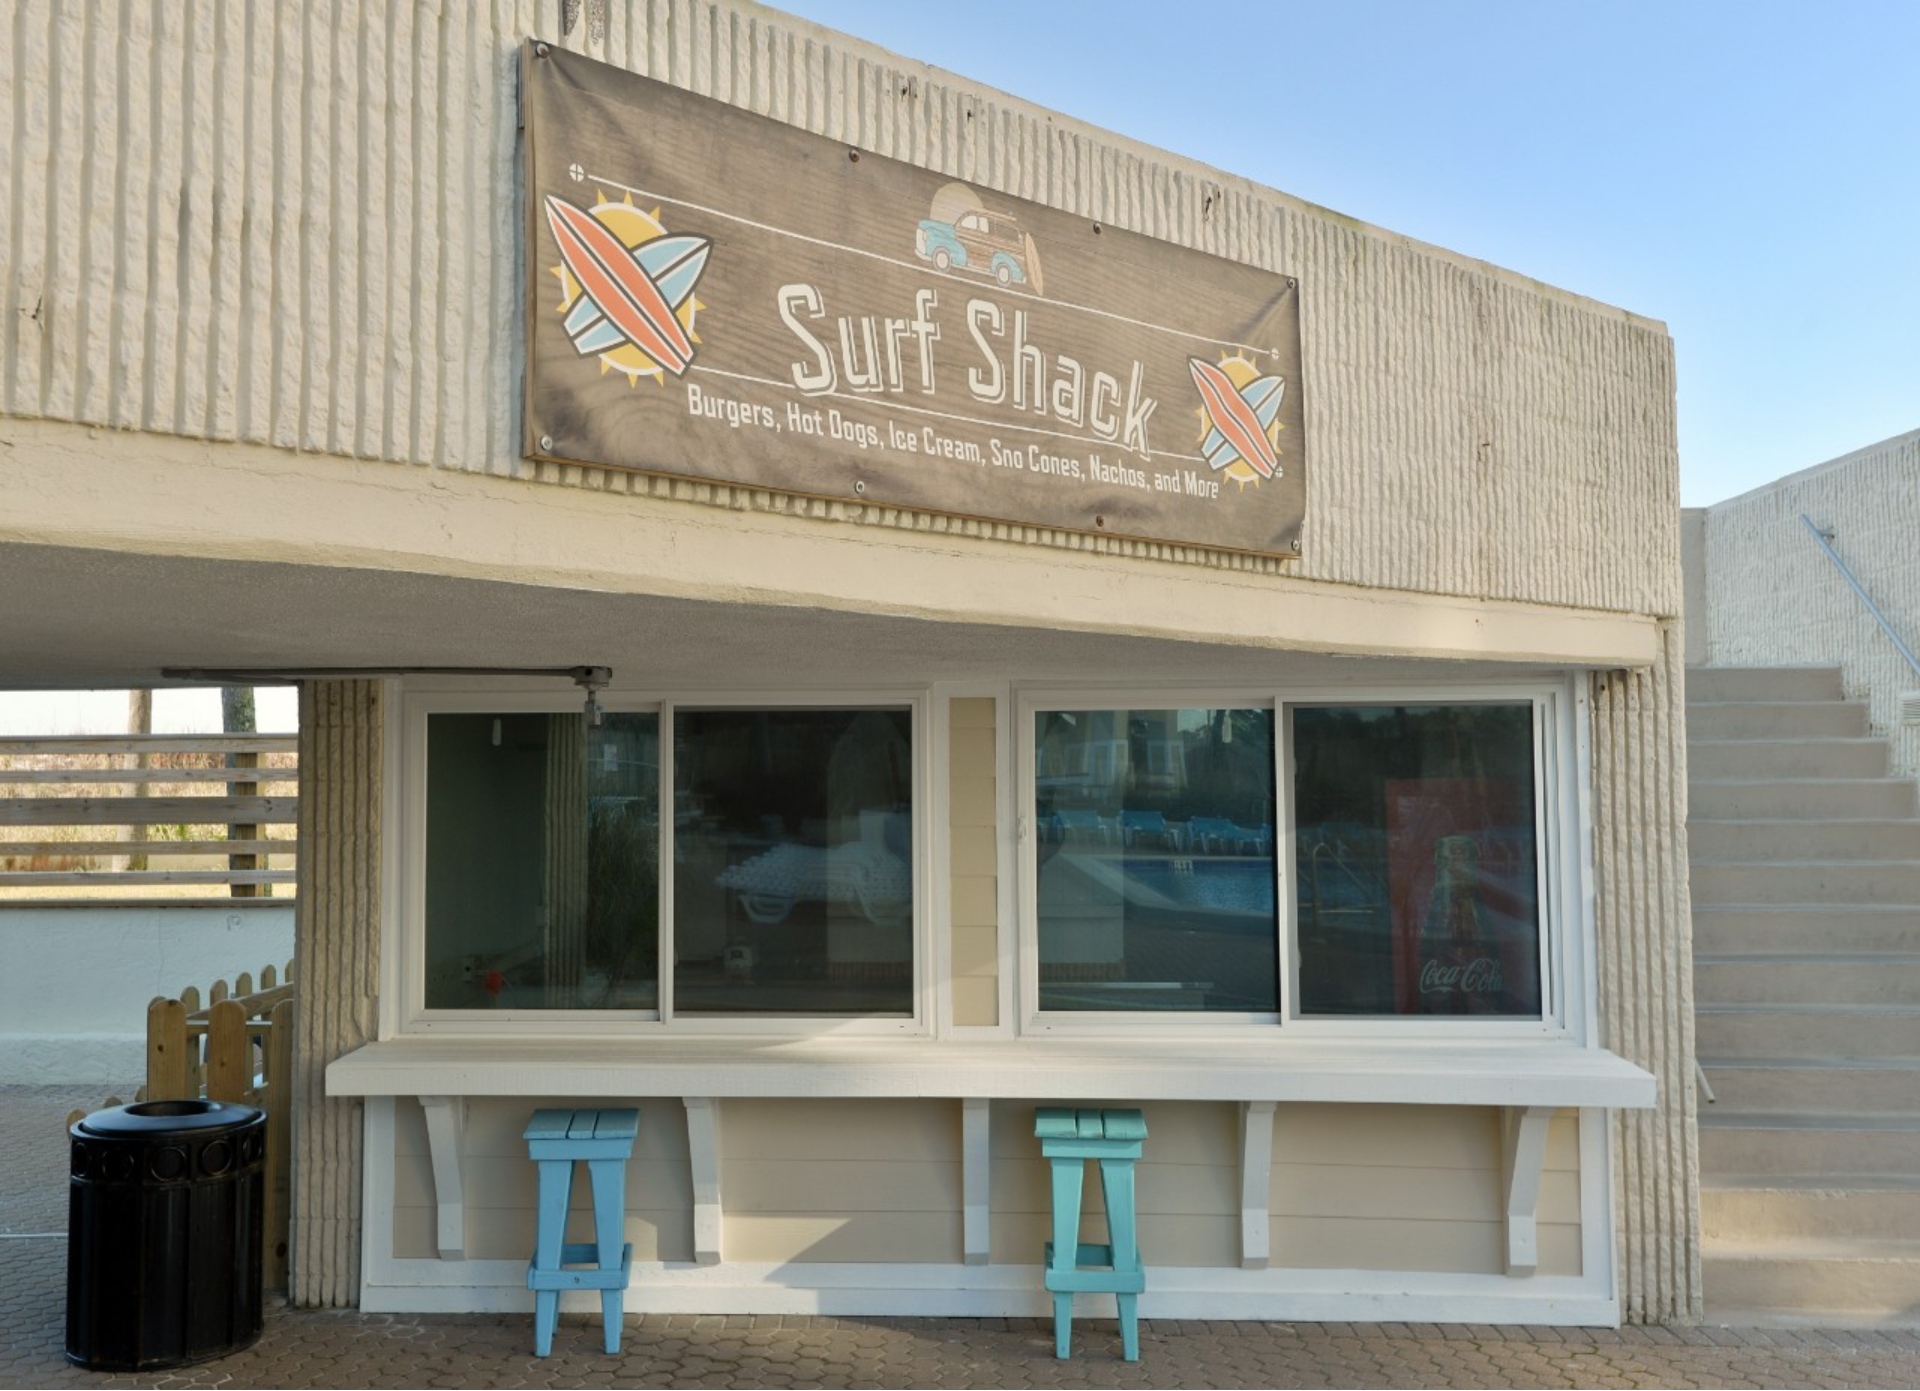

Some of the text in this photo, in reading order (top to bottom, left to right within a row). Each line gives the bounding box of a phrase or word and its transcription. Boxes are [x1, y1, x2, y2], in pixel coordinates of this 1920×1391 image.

[687, 383, 1219, 498] Burgers, Hot Dogs, Ice Cream, Sno Cones, Nachos, and More
[777, 283, 1157, 461] Surf Shack
